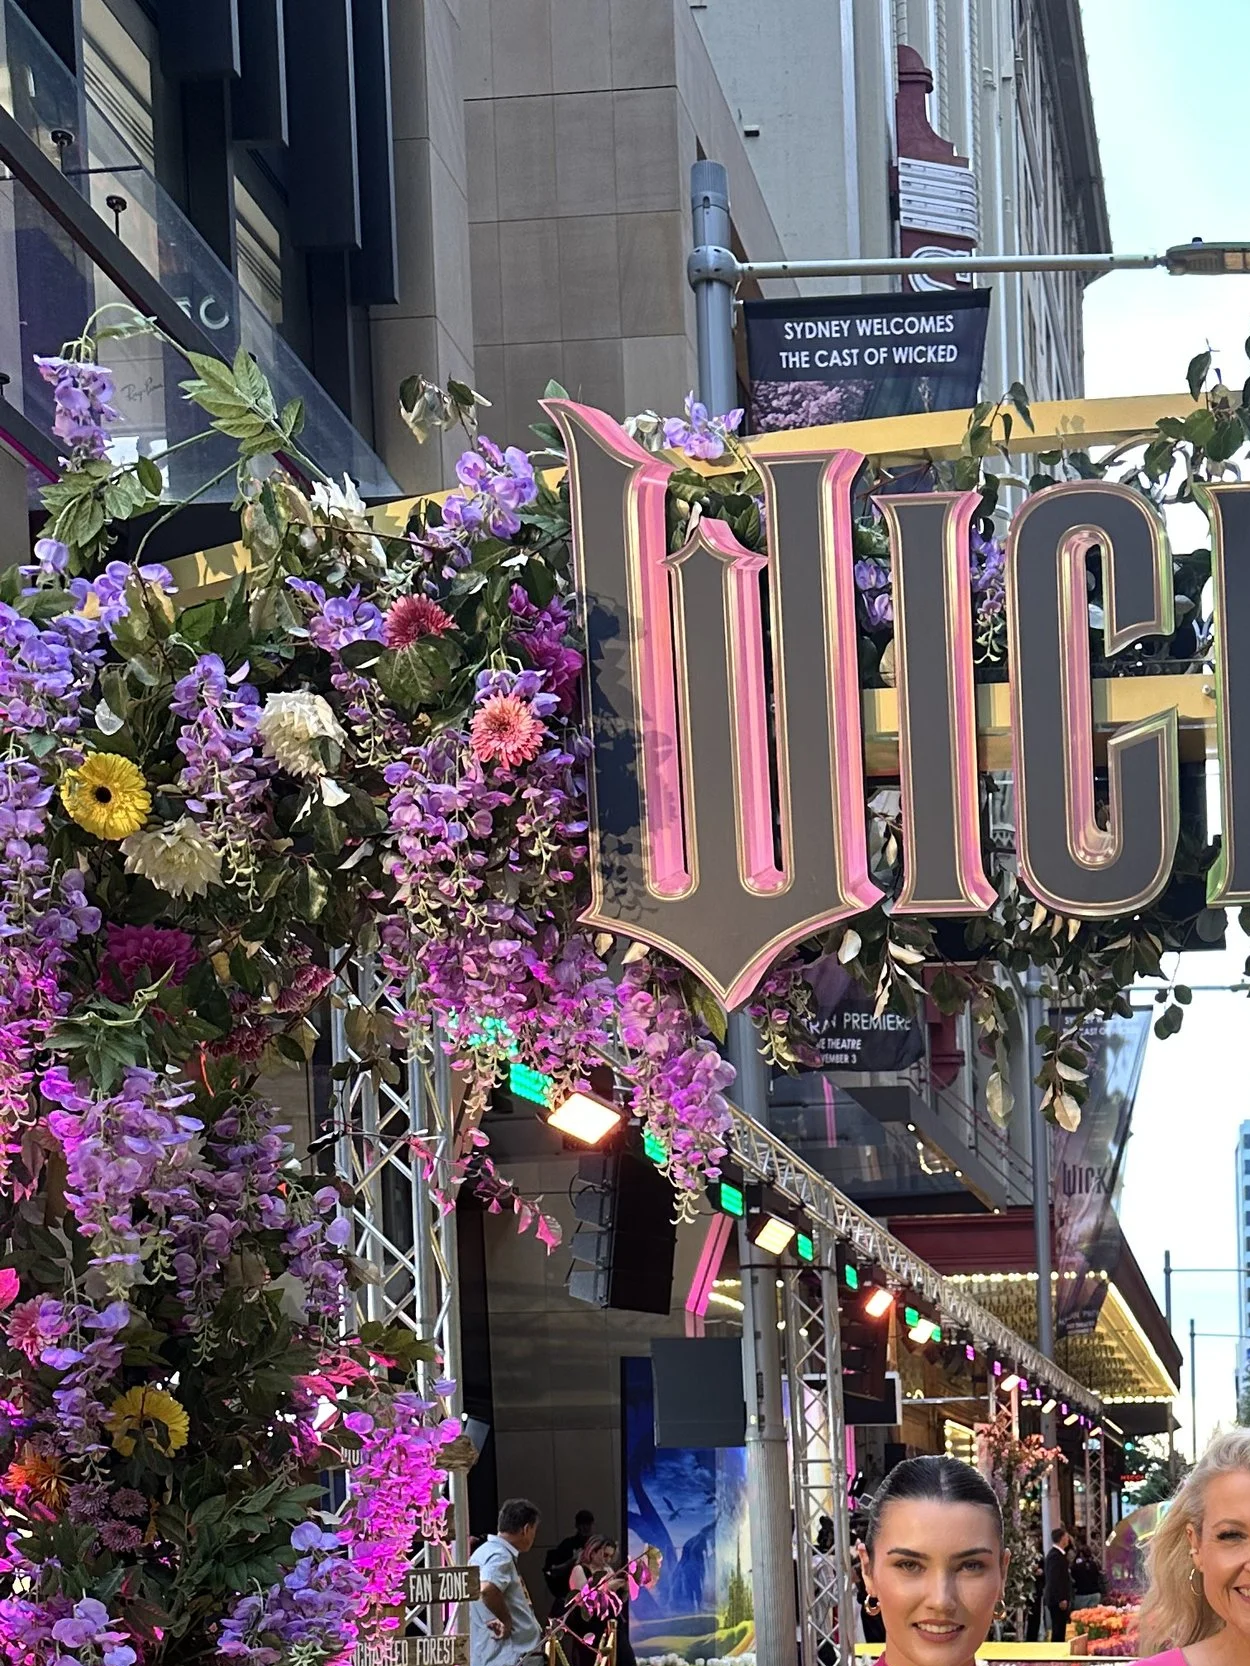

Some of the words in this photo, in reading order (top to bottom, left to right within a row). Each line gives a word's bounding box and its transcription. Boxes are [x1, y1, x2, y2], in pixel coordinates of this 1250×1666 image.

[784, 320, 851, 340] SYDNEY
[856, 315, 954, 336] WELCOMES
[779, 351, 810, 369] THE
[814, 348, 859, 367] CAST
[863, 347, 888, 365] OF
[892, 345, 958, 364] WICKED
[827, 1037, 862, 1050] THEATRE
[851, 1053, 857, 1064] 3
[1062, 1161, 1110, 1198] WICK
[409, 1573, 433, 1603] FAN
[438, 1572, 470, 1601] ZONE
[416, 1636, 457, 1666] FOREST
